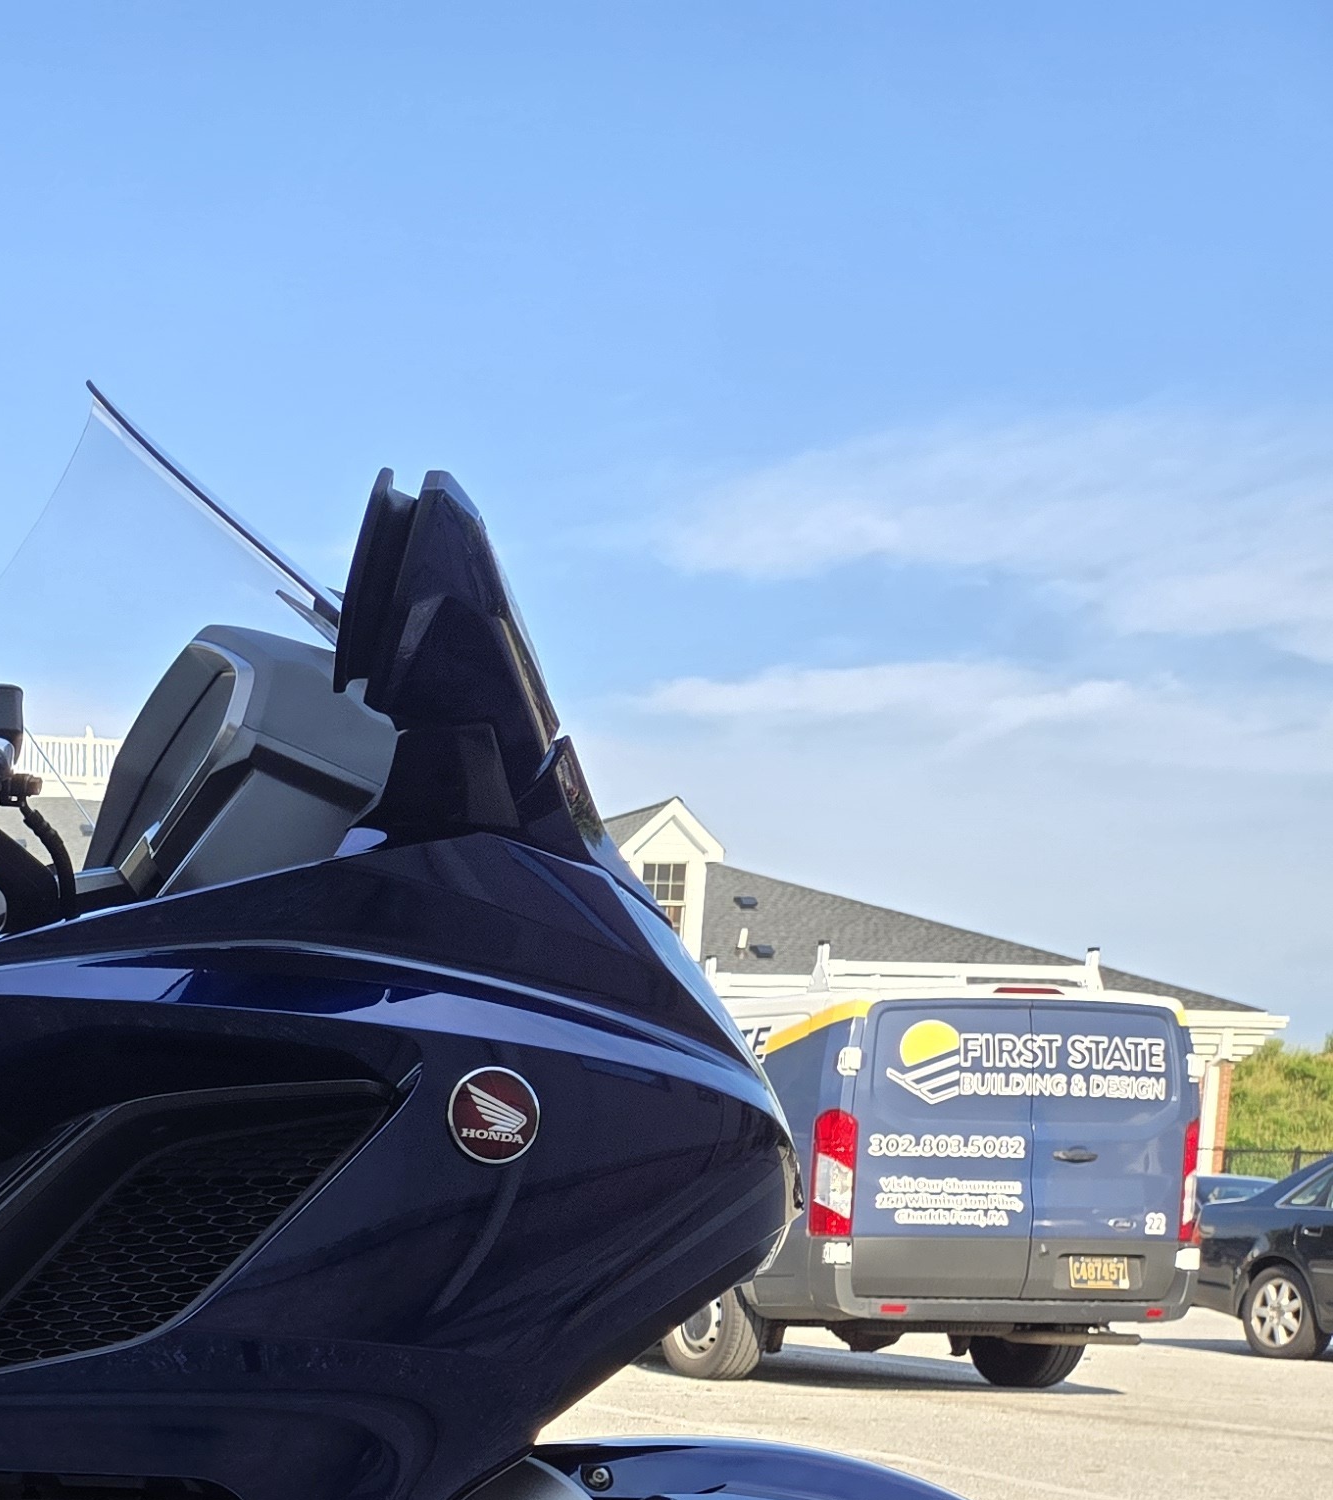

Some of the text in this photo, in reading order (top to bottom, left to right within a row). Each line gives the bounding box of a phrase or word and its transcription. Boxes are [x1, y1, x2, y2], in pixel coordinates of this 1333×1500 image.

[960, 1033, 1165, 1072] FIRST STATE
[959, 1073, 1165, 1100] BUILDING & DESIGN
[460, 1128, 525, 1144] HONDA
[868, 1134, 1025, 1158] 302.803.5082
[880, 1177, 914, 1193] Visit
[916, 1178, 942, 1193] Our
[906, 1193, 987, 1210] Wilmington
[895, 1210, 949, 1224] Chadds
[987, 1211, 1008, 1225] PA
[1146, 1214, 1166, 1234] 22
